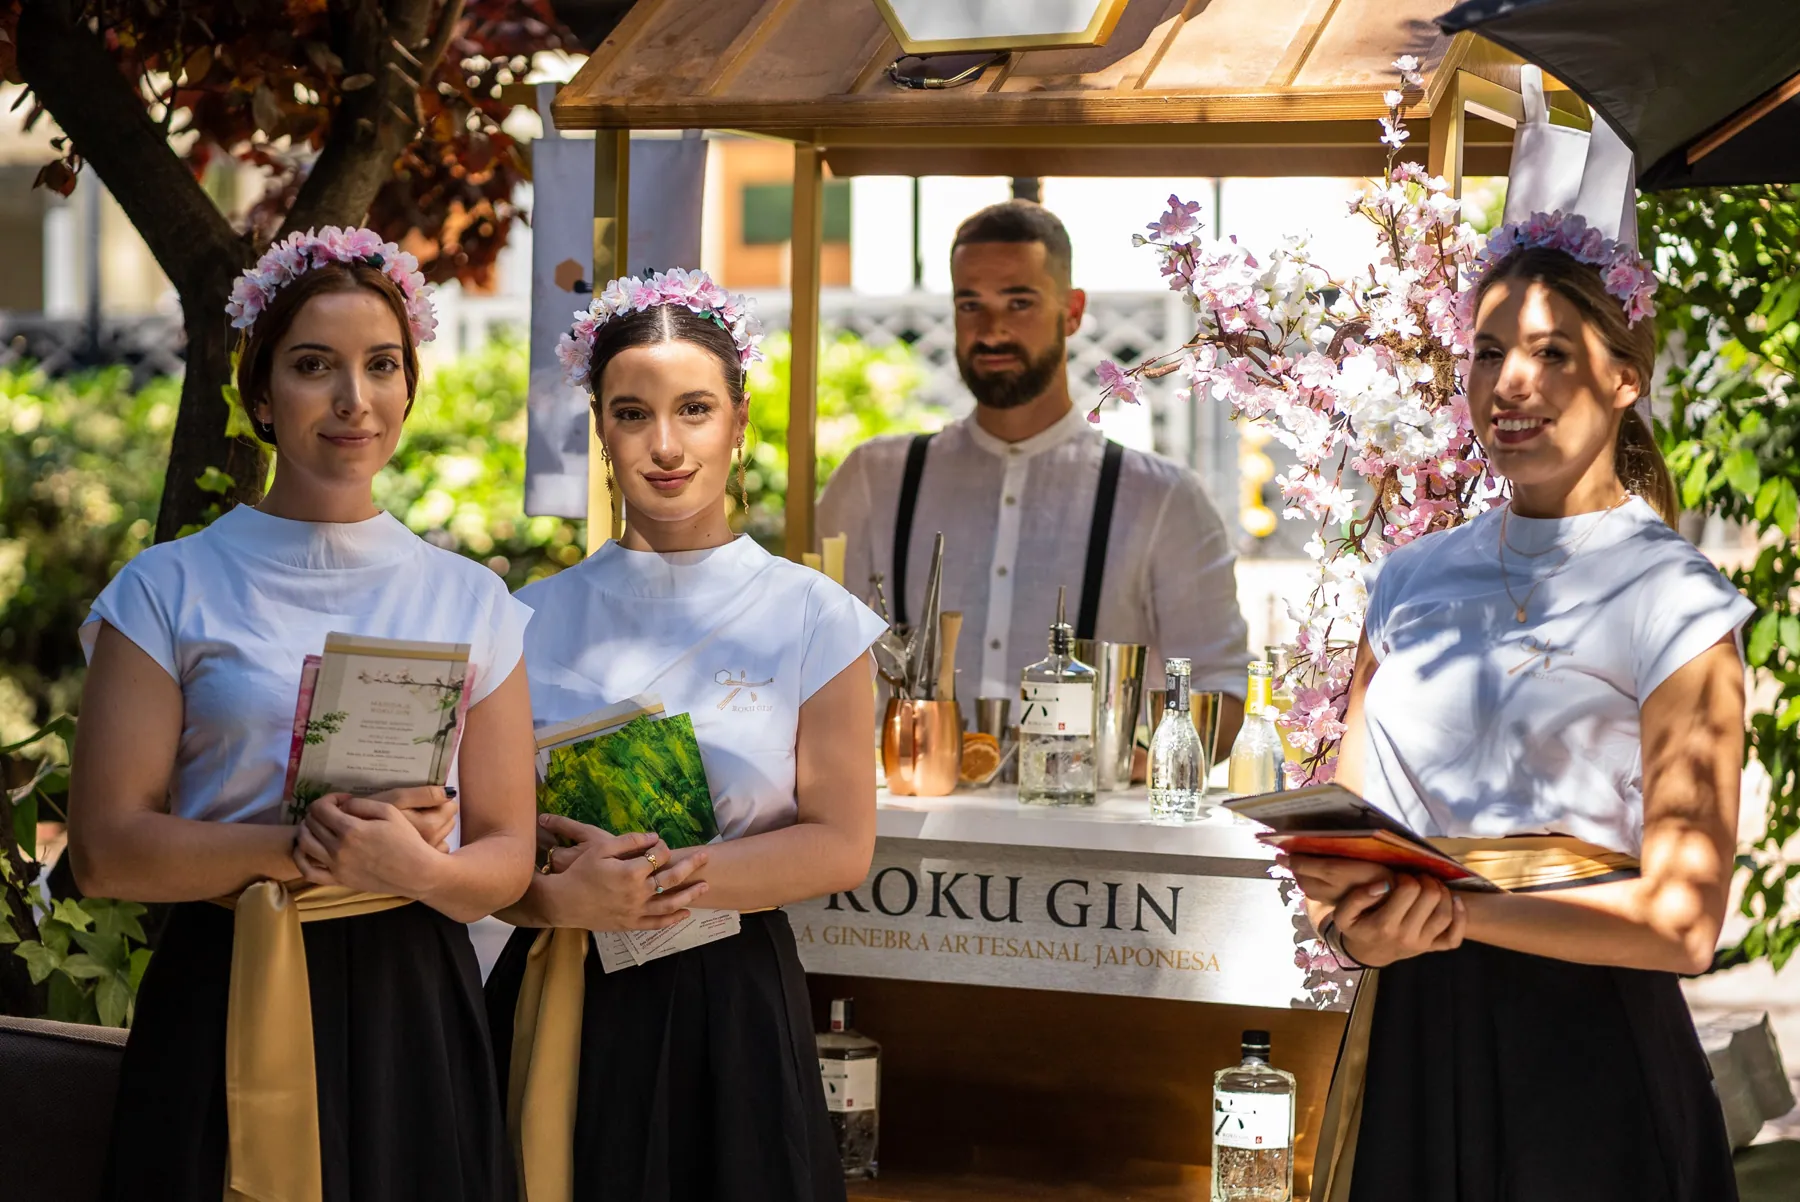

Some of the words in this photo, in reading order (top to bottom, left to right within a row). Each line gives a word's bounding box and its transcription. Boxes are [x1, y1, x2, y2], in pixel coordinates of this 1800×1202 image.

[732, 705, 755, 713] ROKU
[1046, 879, 1184, 935] GIN
[796, 923, 815, 943] A
[823, 925, 930, 951] GINEBRA
[938, 933, 1086, 963] ARTESANAL
[1093, 944, 1220, 972] JAPONESA
